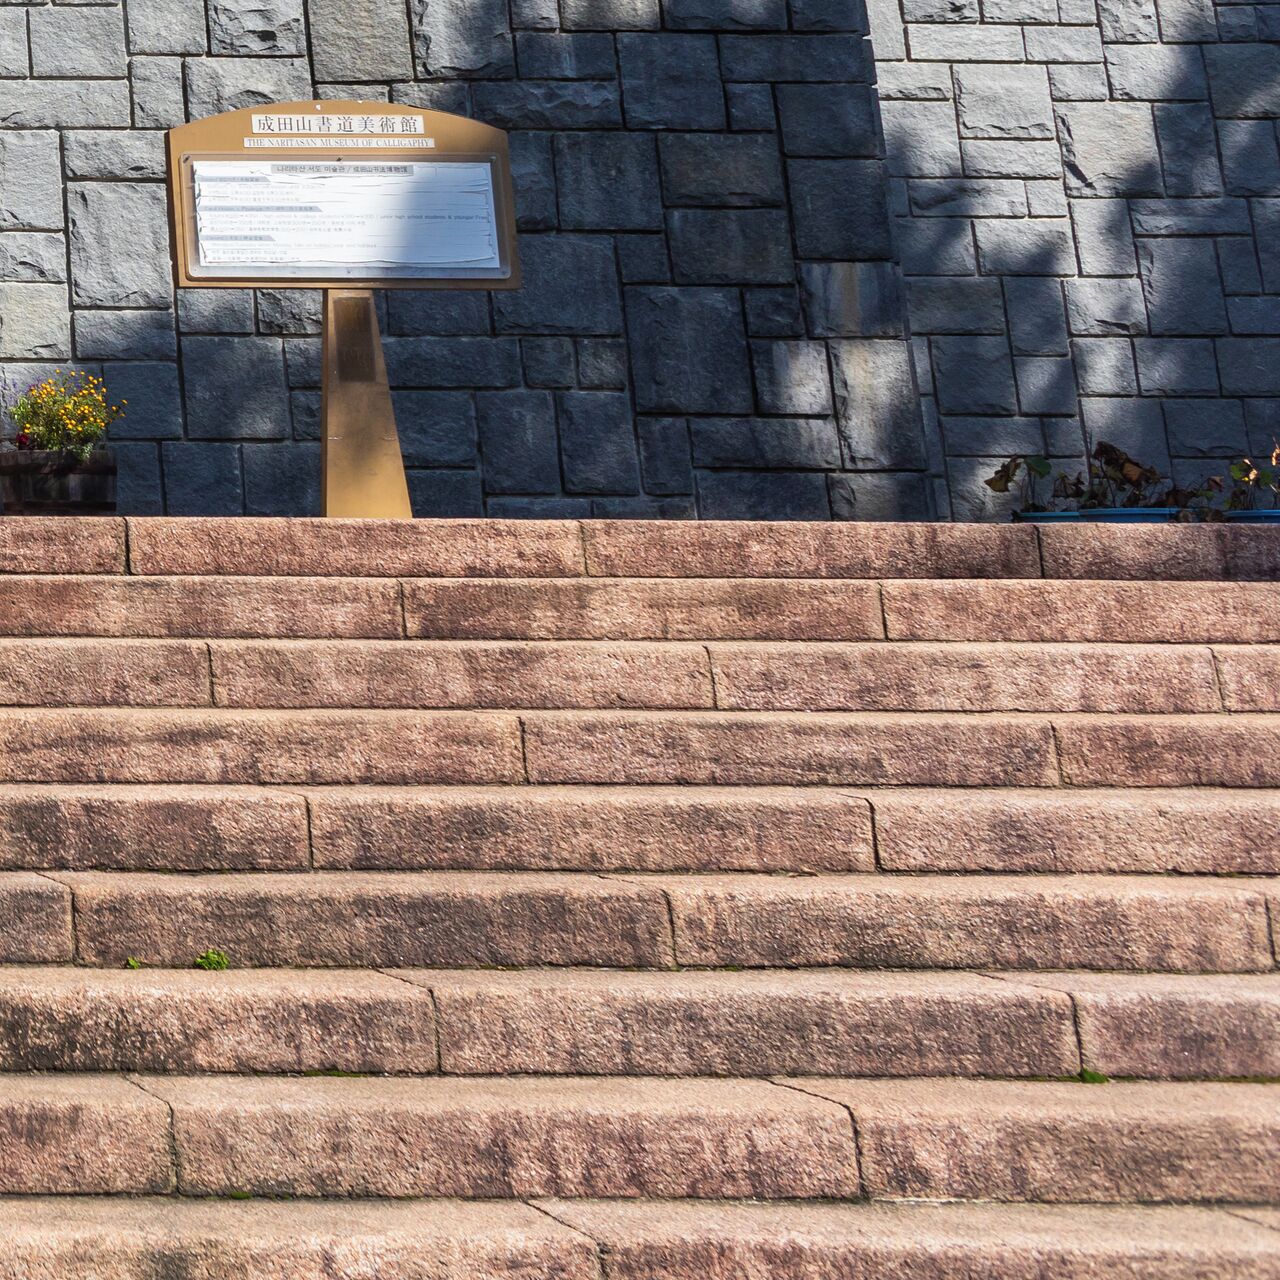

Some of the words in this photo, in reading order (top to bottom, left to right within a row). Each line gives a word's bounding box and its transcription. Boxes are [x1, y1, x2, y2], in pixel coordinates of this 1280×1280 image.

[257, 115, 418, 133] 成田山書道美術館
[247, 138, 265, 147] THE
[268, 138, 317, 147] NARITASAN
[320, 138, 359, 147] MUSEUM
[361, 138, 372, 147] OF
